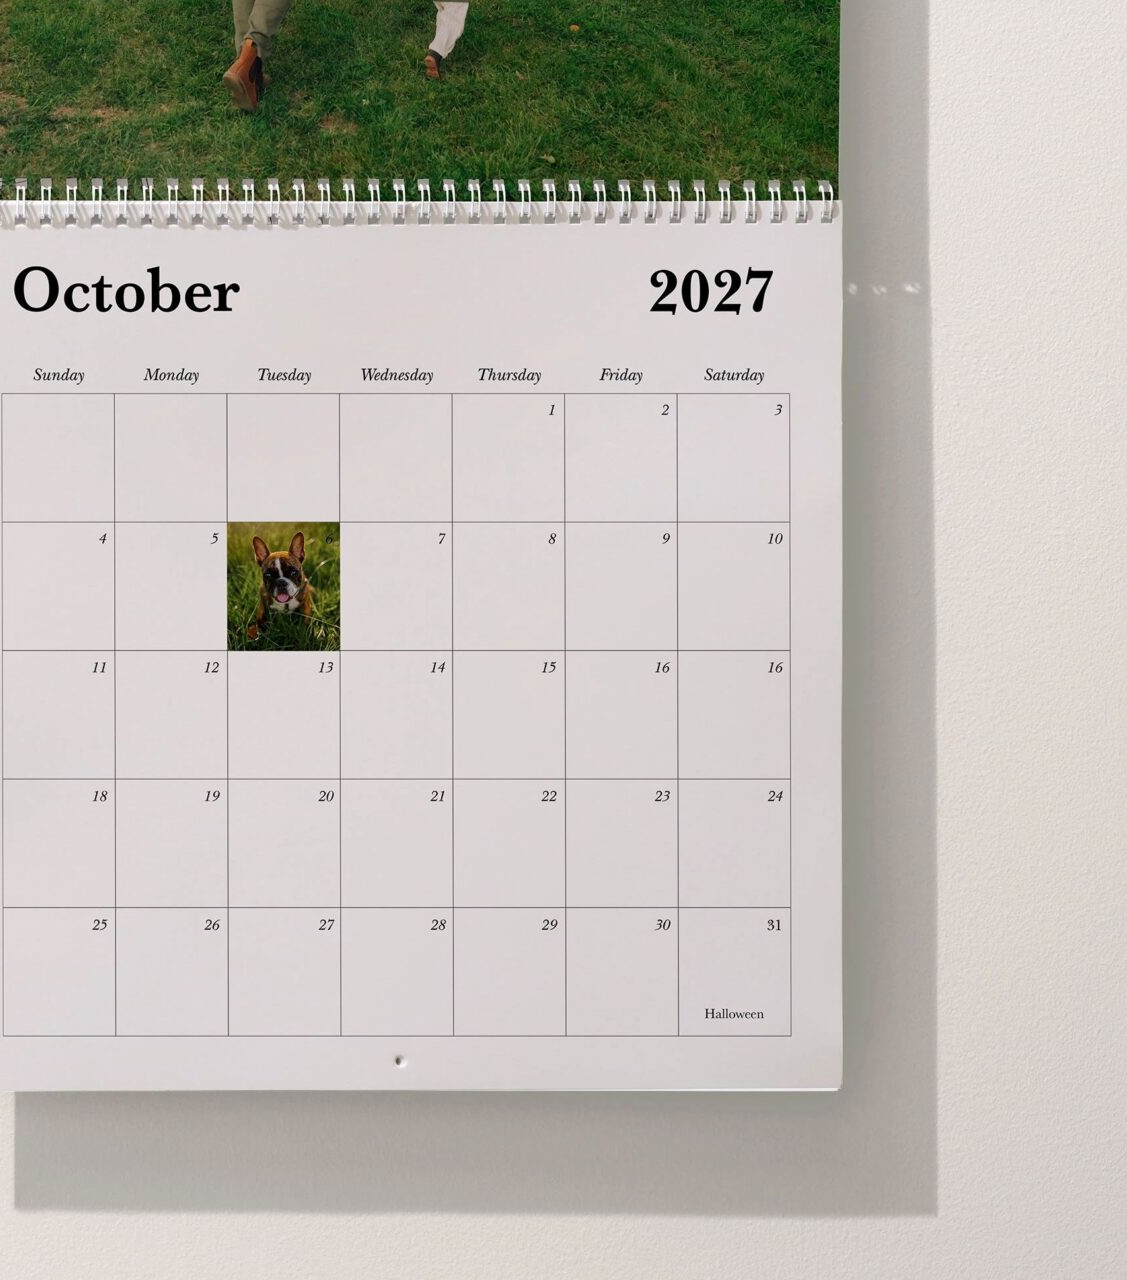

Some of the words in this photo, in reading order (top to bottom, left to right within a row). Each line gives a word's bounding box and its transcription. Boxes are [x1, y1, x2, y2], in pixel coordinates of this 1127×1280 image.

[13, 265, 241, 313] October
[649, 266, 774, 316] 2027
[32, 367, 85, 386] Sunday
[143, 367, 200, 386] Monday
[257, 367, 312, 386] Tuesday
[361, 367, 434, 386] Wednesday
[477, 367, 542, 386] Thursday
[599, 367, 644, 386] Friday
[703, 367, 765, 386] Saturday
[547, 403, 557, 417] 1
[659, 402, 671, 417] 2
[773, 402, 784, 417] 3
[97, 531, 108, 546] 4
[209, 531, 221, 546] 5
[437, 531, 448, 546] 7
[546, 531, 558, 546] 8
[660, 531, 672, 546] 9
[766, 531, 785, 546] 10
[91, 660, 108, 675] 11
[203, 660, 221, 675] 12
[317, 660, 335, 675] 13
[429, 660, 447, 675] 14
[540, 660, 558, 675] 15
[654, 660, 672, 675] 16
[766, 660, 785, 675] 16
[91, 789, 110, 804] 18
[203, 789, 222, 803] 19
[316, 789, 336, 804] 20
[428, 789, 446, 803] 21
[539, 789, 559, 803] 22
[653, 789, 672, 804] 23
[766, 789, 785, 803] 24
[90, 917, 109, 932] 25
[202, 917, 222, 932] 26
[317, 917, 337, 932] 27
[429, 917, 448, 932] 28
[540, 917, 560, 932] 29
[653, 917, 673, 932] 30
[765, 917, 783, 933] 31
[704, 1008, 765, 1020] Halloween
